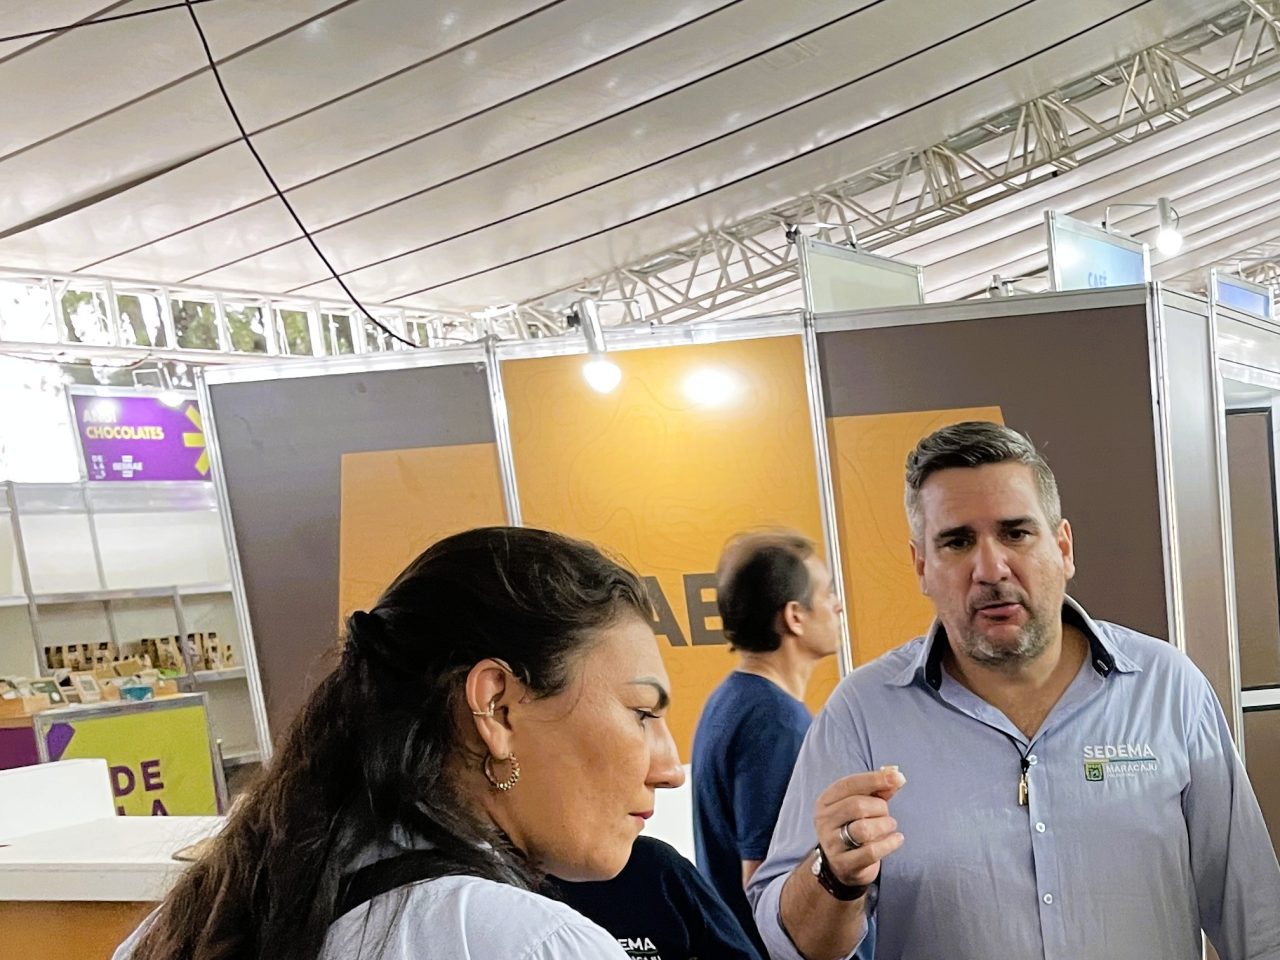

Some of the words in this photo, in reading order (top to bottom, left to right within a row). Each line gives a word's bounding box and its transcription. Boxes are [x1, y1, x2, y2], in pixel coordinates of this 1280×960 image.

[86, 425, 165, 441] CHOCOLATES
[1083, 744, 1154, 759] SEDEMA
[1106, 763, 1158, 773] MARACAJU
[110, 759, 164, 797] DE
